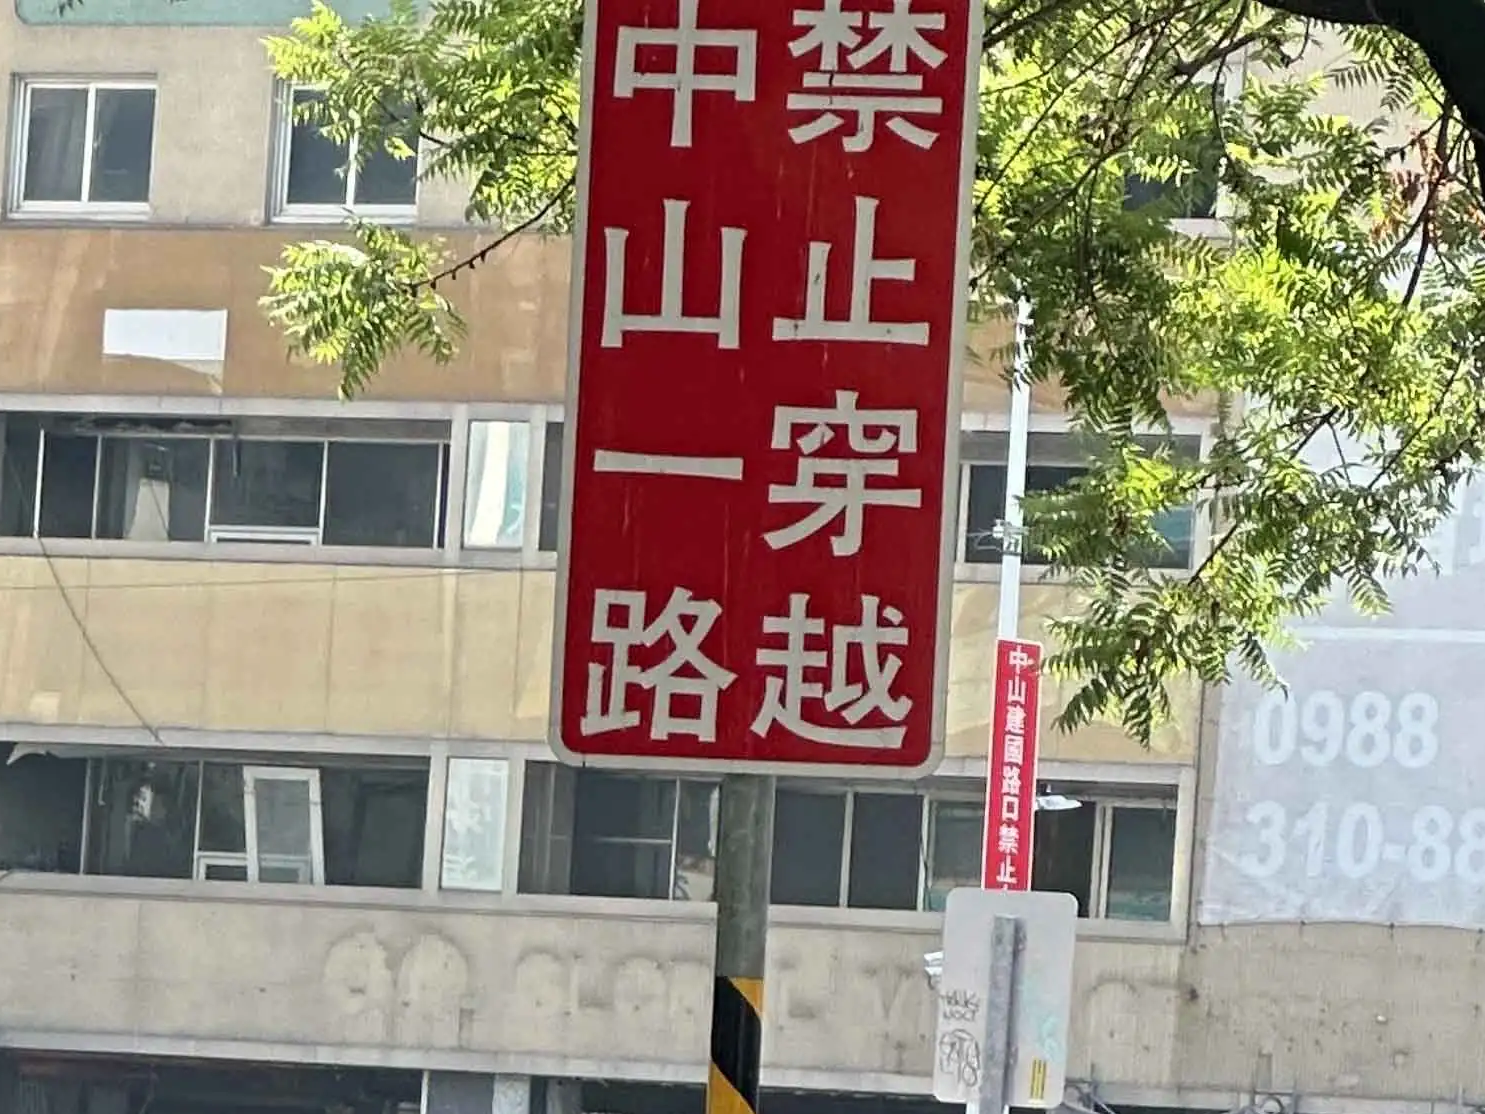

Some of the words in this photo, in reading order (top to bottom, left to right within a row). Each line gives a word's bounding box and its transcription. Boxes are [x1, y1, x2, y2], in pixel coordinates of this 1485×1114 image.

[581, 0, 757, 743] 中山一路
[750, 0, 948, 749] 禁止穿越
[995, 645, 1027, 890] 中山建國路口禁止
[1240, 800, 1485, 883] 310-88
[1253, 690, 1439, 768] 0988
